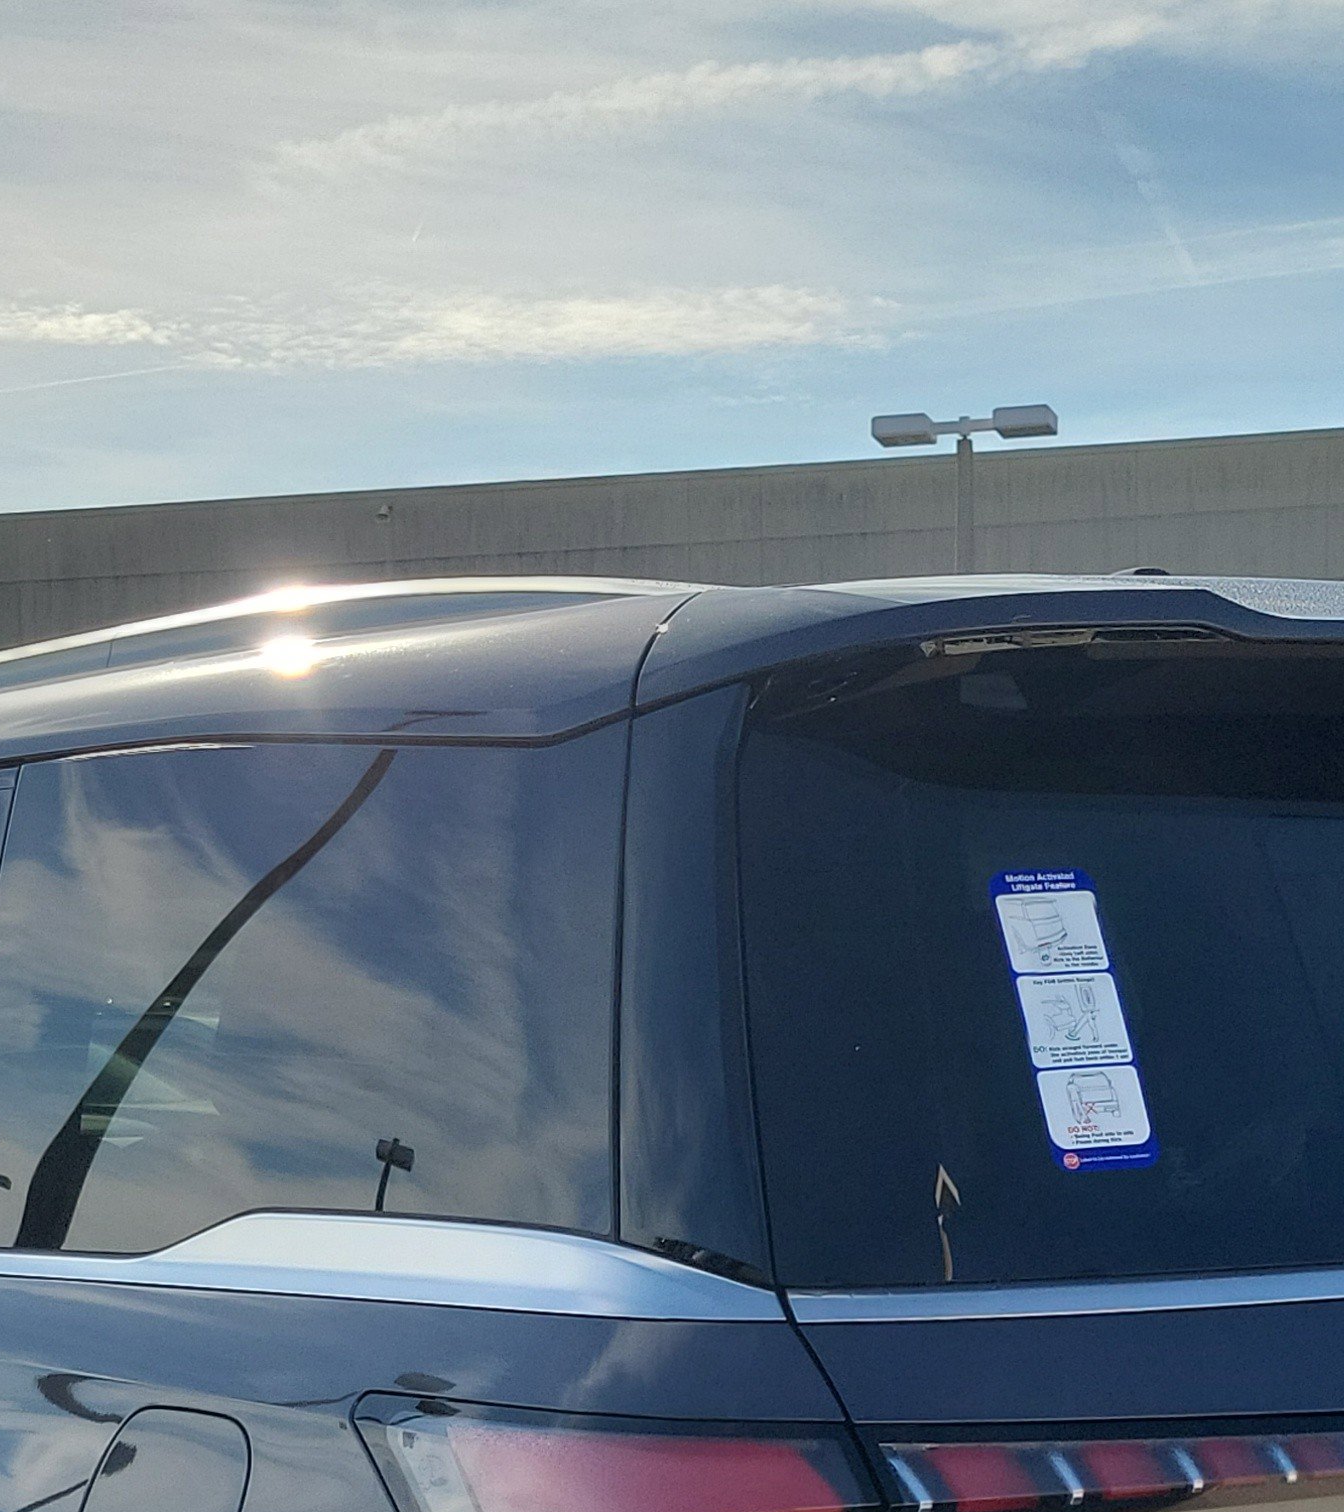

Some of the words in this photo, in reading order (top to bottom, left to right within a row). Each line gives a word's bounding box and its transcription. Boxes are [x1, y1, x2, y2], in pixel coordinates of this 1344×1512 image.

[1004, 874, 1035, 883] Motion
[1036, 871, 1075, 881] Activated
[1011, 883, 1043, 892] Liftgate
[1044, 881, 1076, 890] Feature
